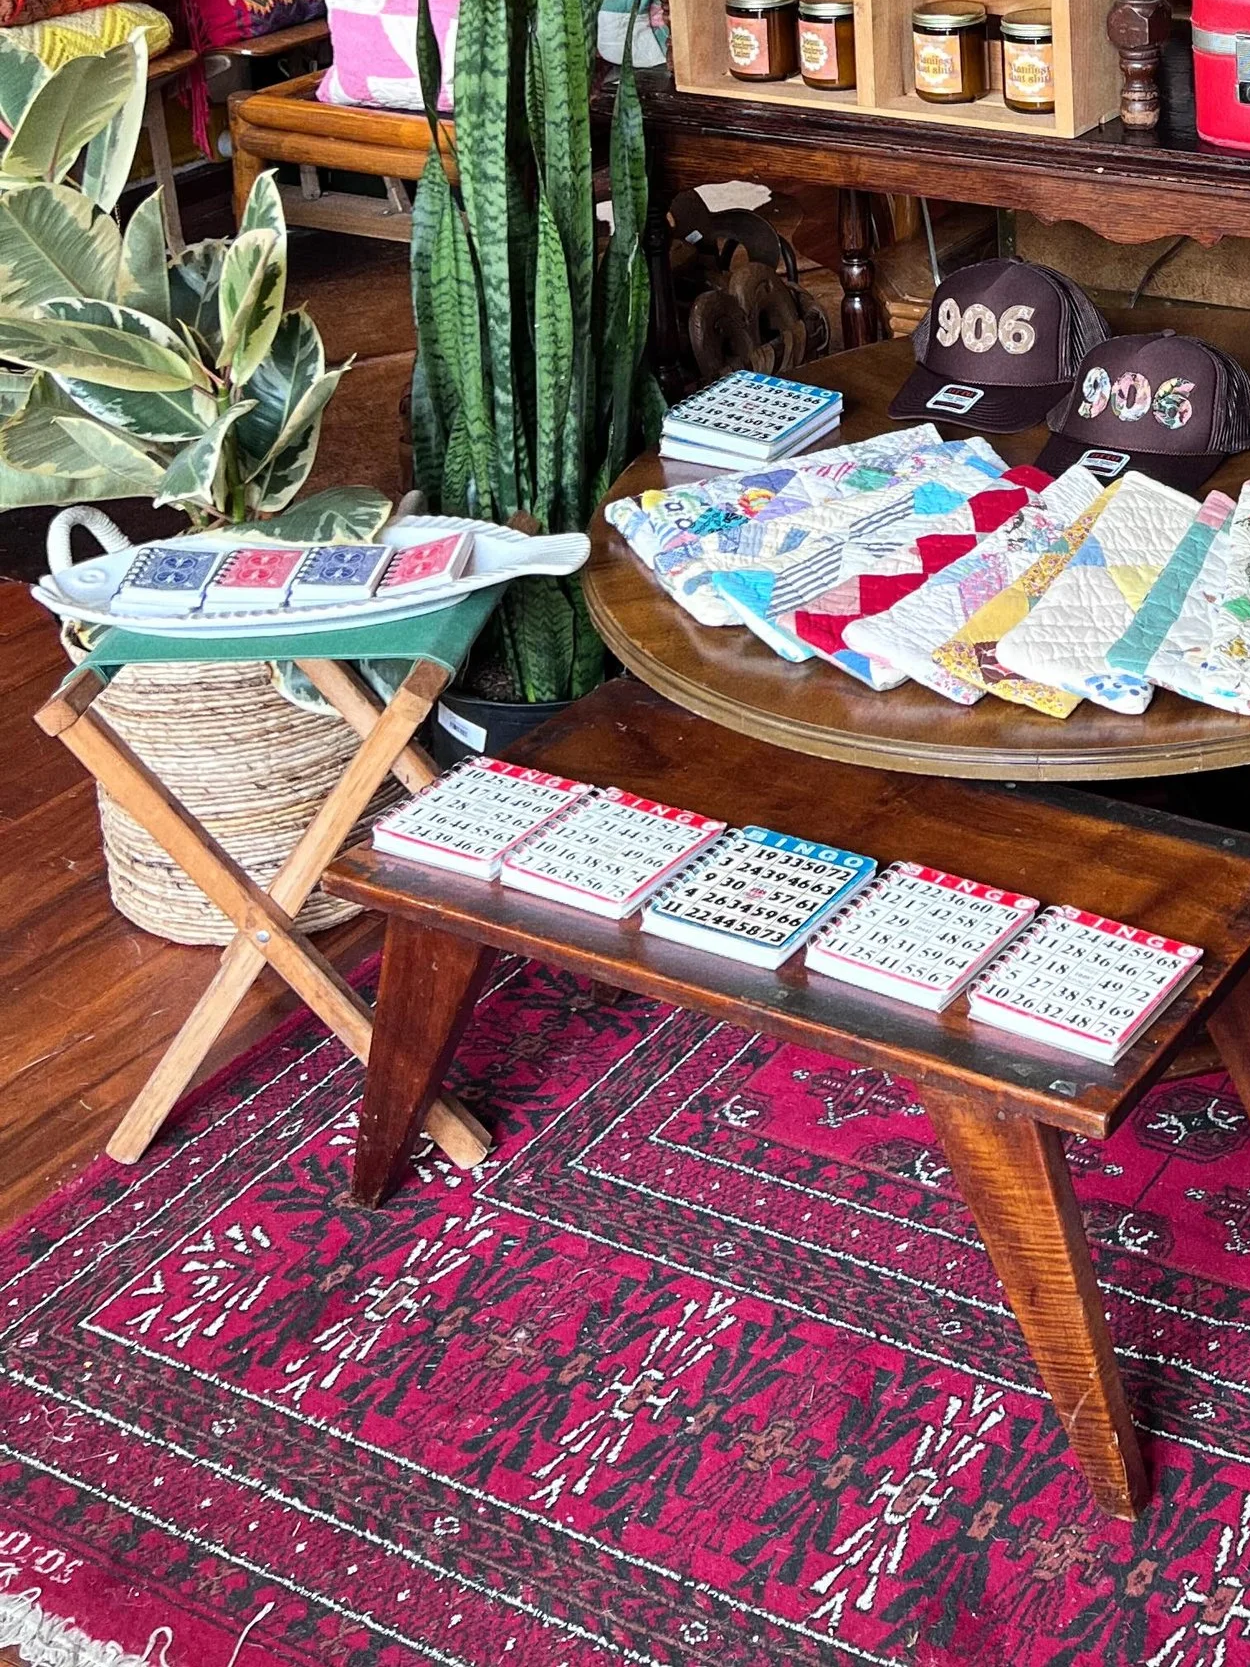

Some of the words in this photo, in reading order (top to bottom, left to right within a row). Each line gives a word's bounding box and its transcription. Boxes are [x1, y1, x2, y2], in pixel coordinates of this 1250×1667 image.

[936, 297, 1036, 355] 906
[1077, 366, 1196, 430] 906
[719, 857, 734, 866] 3
[736, 862, 764, 875] 24
[761, 869, 787, 882] 39
[788, 877, 810, 889] 46
[810, 883, 836, 895] 63
[734, 843, 749, 853] 2
[755, 849, 778, 861] 19
[778, 855, 804, 868] 33
[801, 862, 827, 874] 50
[827, 868, 851, 881] 72
[685, 888, 698, 897] 4
[702, 892, 728, 906] 26
[726, 899, 754, 913] 34
[751, 907, 778, 920] 59
[777, 914, 802, 927] 66
[704, 873, 718, 882] 9
[720, 877, 746, 890] 30
[768, 891, 796, 904] 57
[795, 900, 819, 912] 61
[880, 892, 902, 904] 12
[904, 899, 929, 914] 17
[928, 909, 952, 920] 42
[953, 915, 978, 928] 58
[981, 922, 1003, 936] 73
[896, 877, 916, 890] 14
[919, 886, 943, 898] 22
[942, 894, 966, 906] 36
[969, 902, 993, 914] 60
[997, 908, 1019, 921] 70
[662, 900, 680, 913] 11
[684, 905, 708, 922] 22
[712, 912, 735, 928] 44
[734, 920, 759, 936] 58
[760, 928, 787, 943] 73
[864, 908, 877, 918] 5
[886, 915, 910, 927] 29
[936, 932, 961, 944] 48
[962, 940, 986, 952] 62
[826, 938, 848, 951] 11
[850, 947, 876, 960] 25
[876, 956, 900, 969] 41
[901, 964, 927, 977] 55
[927, 972, 953, 985] 67
[848, 924, 861, 934] 2
[869, 932, 892, 944] 18
[891, 940, 916, 953] 31
[919, 948, 943, 960] 59
[944, 957, 969, 969] 64
[1037, 936, 1058, 948] 11
[1061, 944, 1086, 958] 28
[1086, 953, 1110, 967] 36
[1115, 964, 1137, 976] 46
[1143, 970, 1167, 985] 74
[1055, 923, 1070, 932] 8
[1075, 926, 1100, 943] 24
[1103, 940, 1127, 952] 44
[1129, 948, 1154, 959] 59
[1156, 957, 1181, 969] 68
[1006, 970, 1020, 979] 5
[1027, 976, 1054, 991] 27
[1053, 987, 1080, 1001] 38
[1081, 996, 1107, 1010] 53
[1109, 1007, 1135, 1018] 69
[1021, 951, 1043, 965] 12
[1046, 961, 1070, 974] 18
[1098, 980, 1123, 992] 49
[1126, 987, 1151, 1002] 72
[986, 984, 1010, 999] 10
[1011, 994, 1034, 1008] 26
[1036, 1003, 1063, 1019] 32
[1066, 1014, 1091, 1028] 48
[1096, 1022, 1121, 1038] 75
